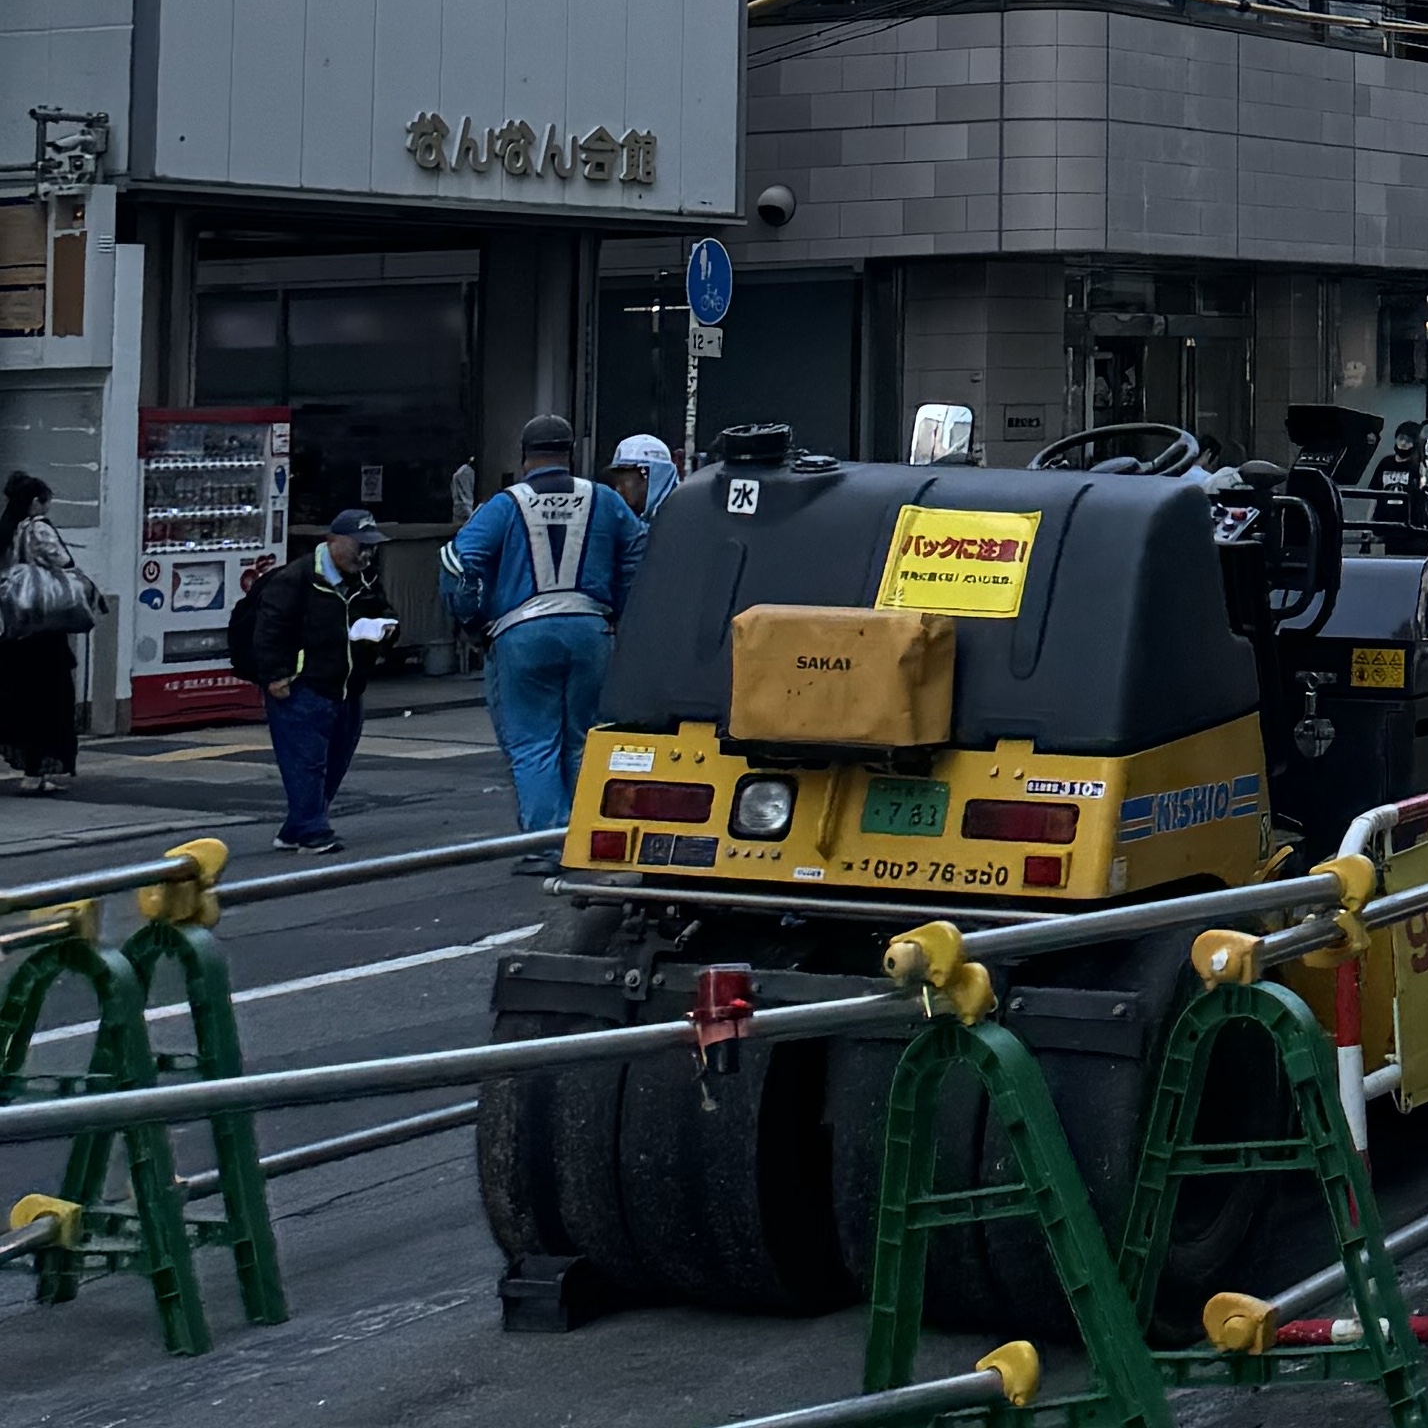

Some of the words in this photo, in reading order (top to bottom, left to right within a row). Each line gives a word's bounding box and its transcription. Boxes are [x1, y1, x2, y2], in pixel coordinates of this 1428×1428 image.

[406, 111, 658, 185] なんなん会館
[731, 483, 755, 509] 水
[796, 655, 852, 672] SAKAI
[1155, 783, 1230, 834] NISHIO
